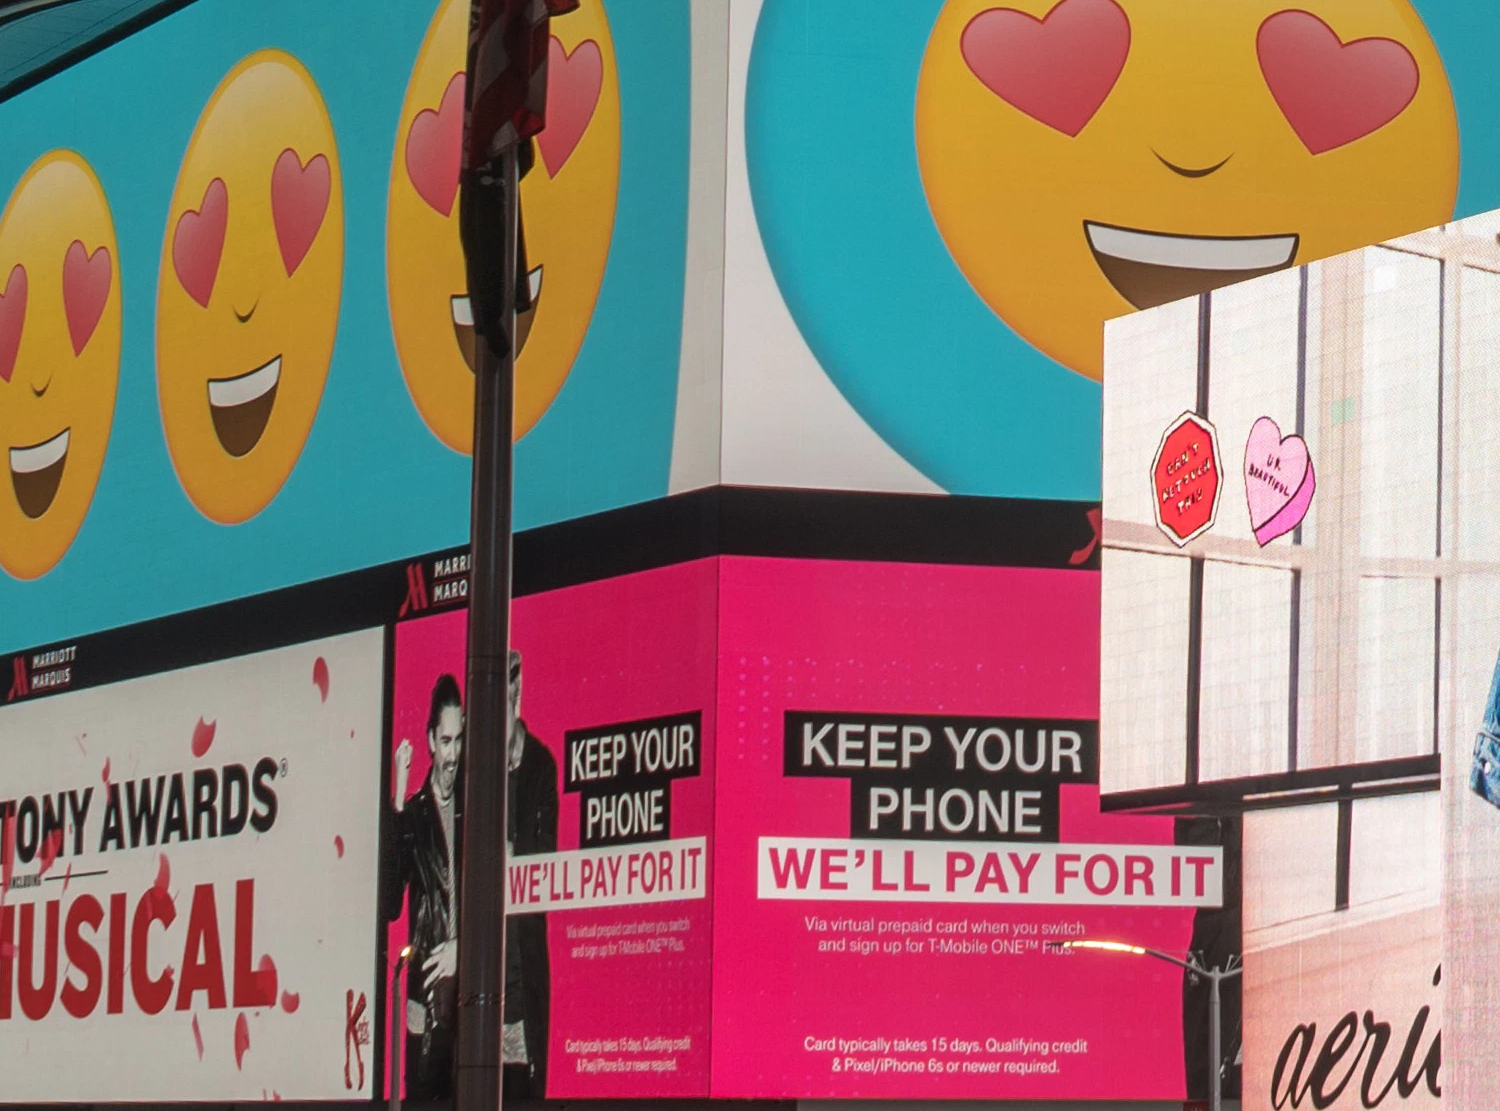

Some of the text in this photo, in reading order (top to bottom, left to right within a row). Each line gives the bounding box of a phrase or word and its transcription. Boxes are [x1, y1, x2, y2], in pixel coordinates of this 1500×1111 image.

[434, 553, 472, 578] MARRI
[433, 579, 468, 602] MARQ
[32, 645, 77, 669] MARRIOTT
[571, 723, 696, 784] KEEP YOUR
[803, 722, 1082, 774] KEEP YOUR
[586, 789, 664, 841] PHONE
[869, 787, 1042, 834] PHONE
[580, 855, 622, 899] PAY
[628, 850, 673, 894] FOR
[680, 847, 701, 890] IT
[945, 851, 1042, 894] PAY
[1054, 853, 1154, 897] FOR
[1171, 856, 1214, 897] IT
[804, 917, 1085, 936] Via virtual prepaid card when you switch
[818, 938, 845, 952] and
[849, 938, 878, 955] sign
[883, 941, 900, 955] up
[905, 938, 924, 953] for
[927, 939, 988, 954] T-Mobile
[804, 1036, 1088, 1056] Card typically takes 15 days. Qualifying credit
[832, 1057, 1060, 1076] & Pixel/iPhone 6s or newer required.
